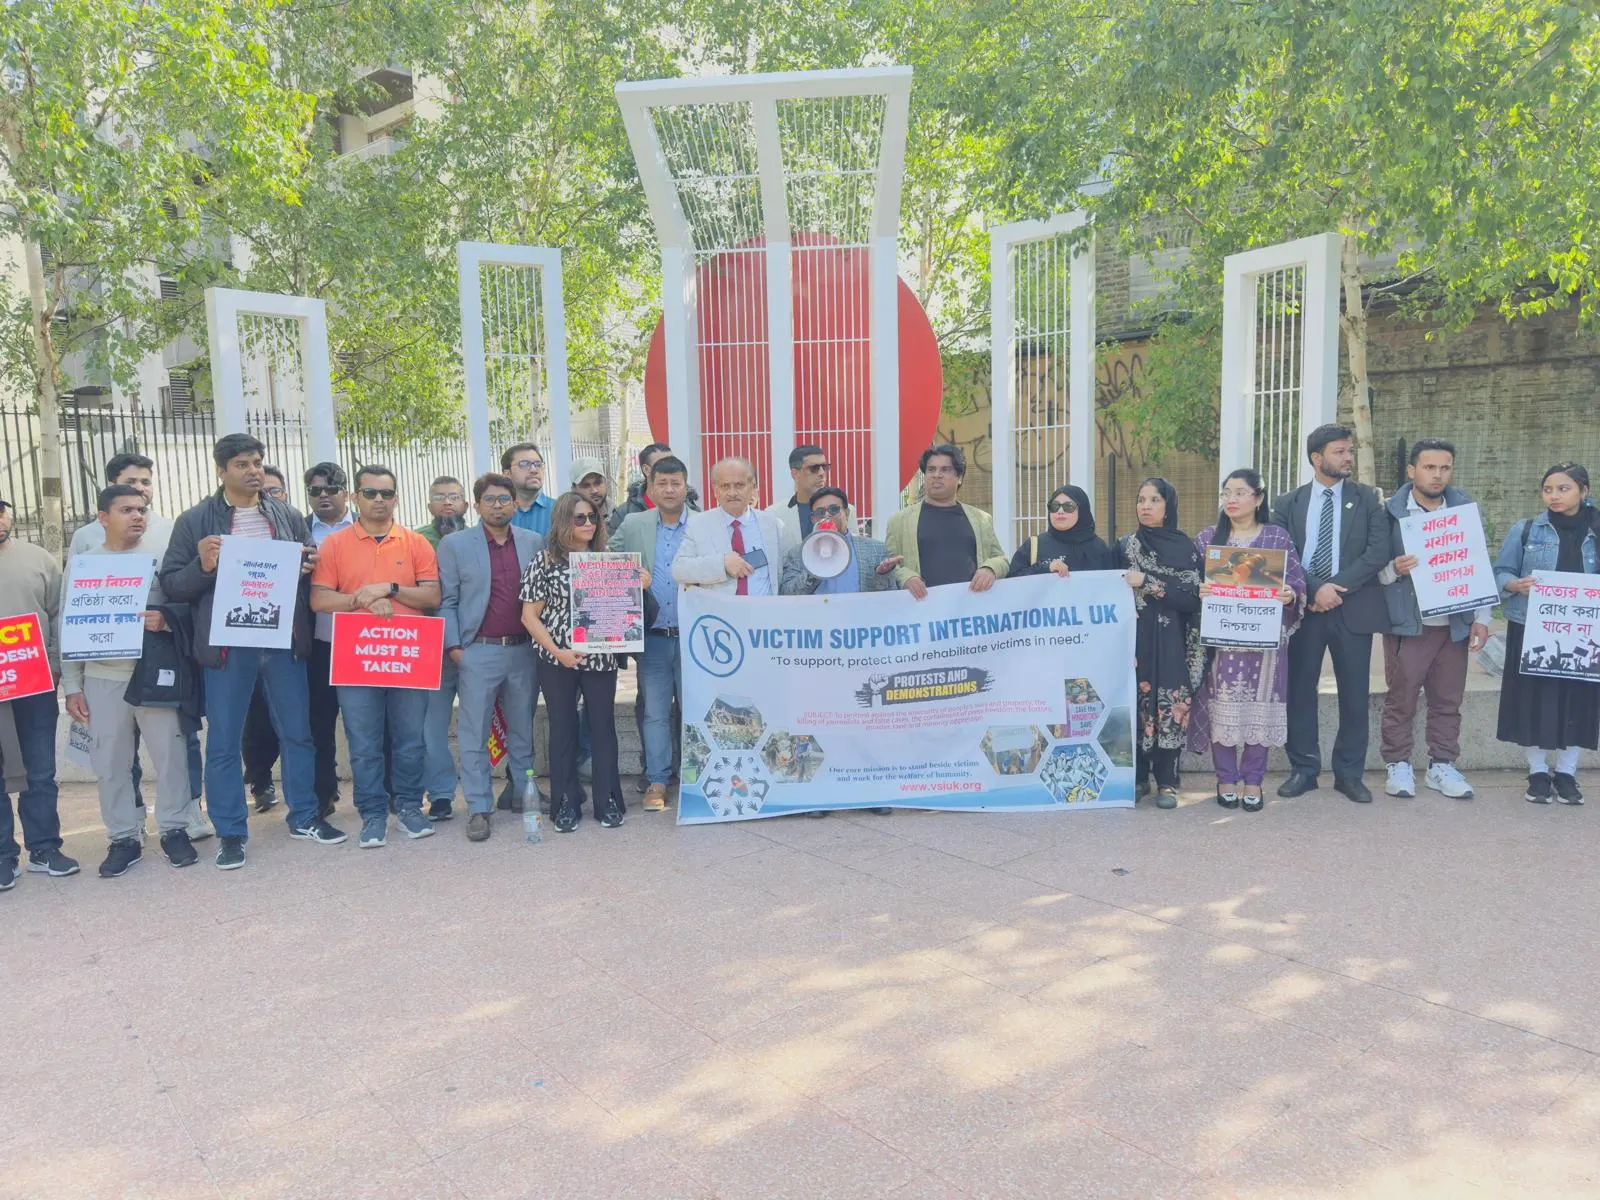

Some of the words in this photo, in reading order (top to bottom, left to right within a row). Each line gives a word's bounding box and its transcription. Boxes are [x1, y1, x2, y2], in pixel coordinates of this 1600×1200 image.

[1422, 514, 1458, 532] মানব
[1534, 584, 1579, 598] সত্যের
[1237, 603, 1276, 616] বিচারের
[1539, 604, 1568, 616] রোধ
[748, 628, 823, 649] VICTIM
[830, 623, 921, 649] SUPPORT
[929, 606, 1083, 642] INTERNATIONAL
[1089, 604, 1118, 625] UK
[1220, 619, 1261, 632] নিশ্চয়তা
[1542, 621, 1573, 636] যাবে
[359, 627, 418, 640] ACTION
[355, 644, 398, 657] MUST
[401, 646, 420, 658] BE
[794, 658, 845, 669] support,
[848, 656, 892, 669] protect
[895, 651, 919, 664] and
[922, 644, 988, 662] rehabilitate
[991, 638, 1031, 653] victims
[1034, 635, 1046, 647] in
[362, 660, 412, 673] TAKEN
[894, 672, 946, 688] PROTESTS
[947, 669, 968, 682] AND
[886, 681, 977, 700] DEMONSTRATIONS
[929, 760, 952, 769] beside
